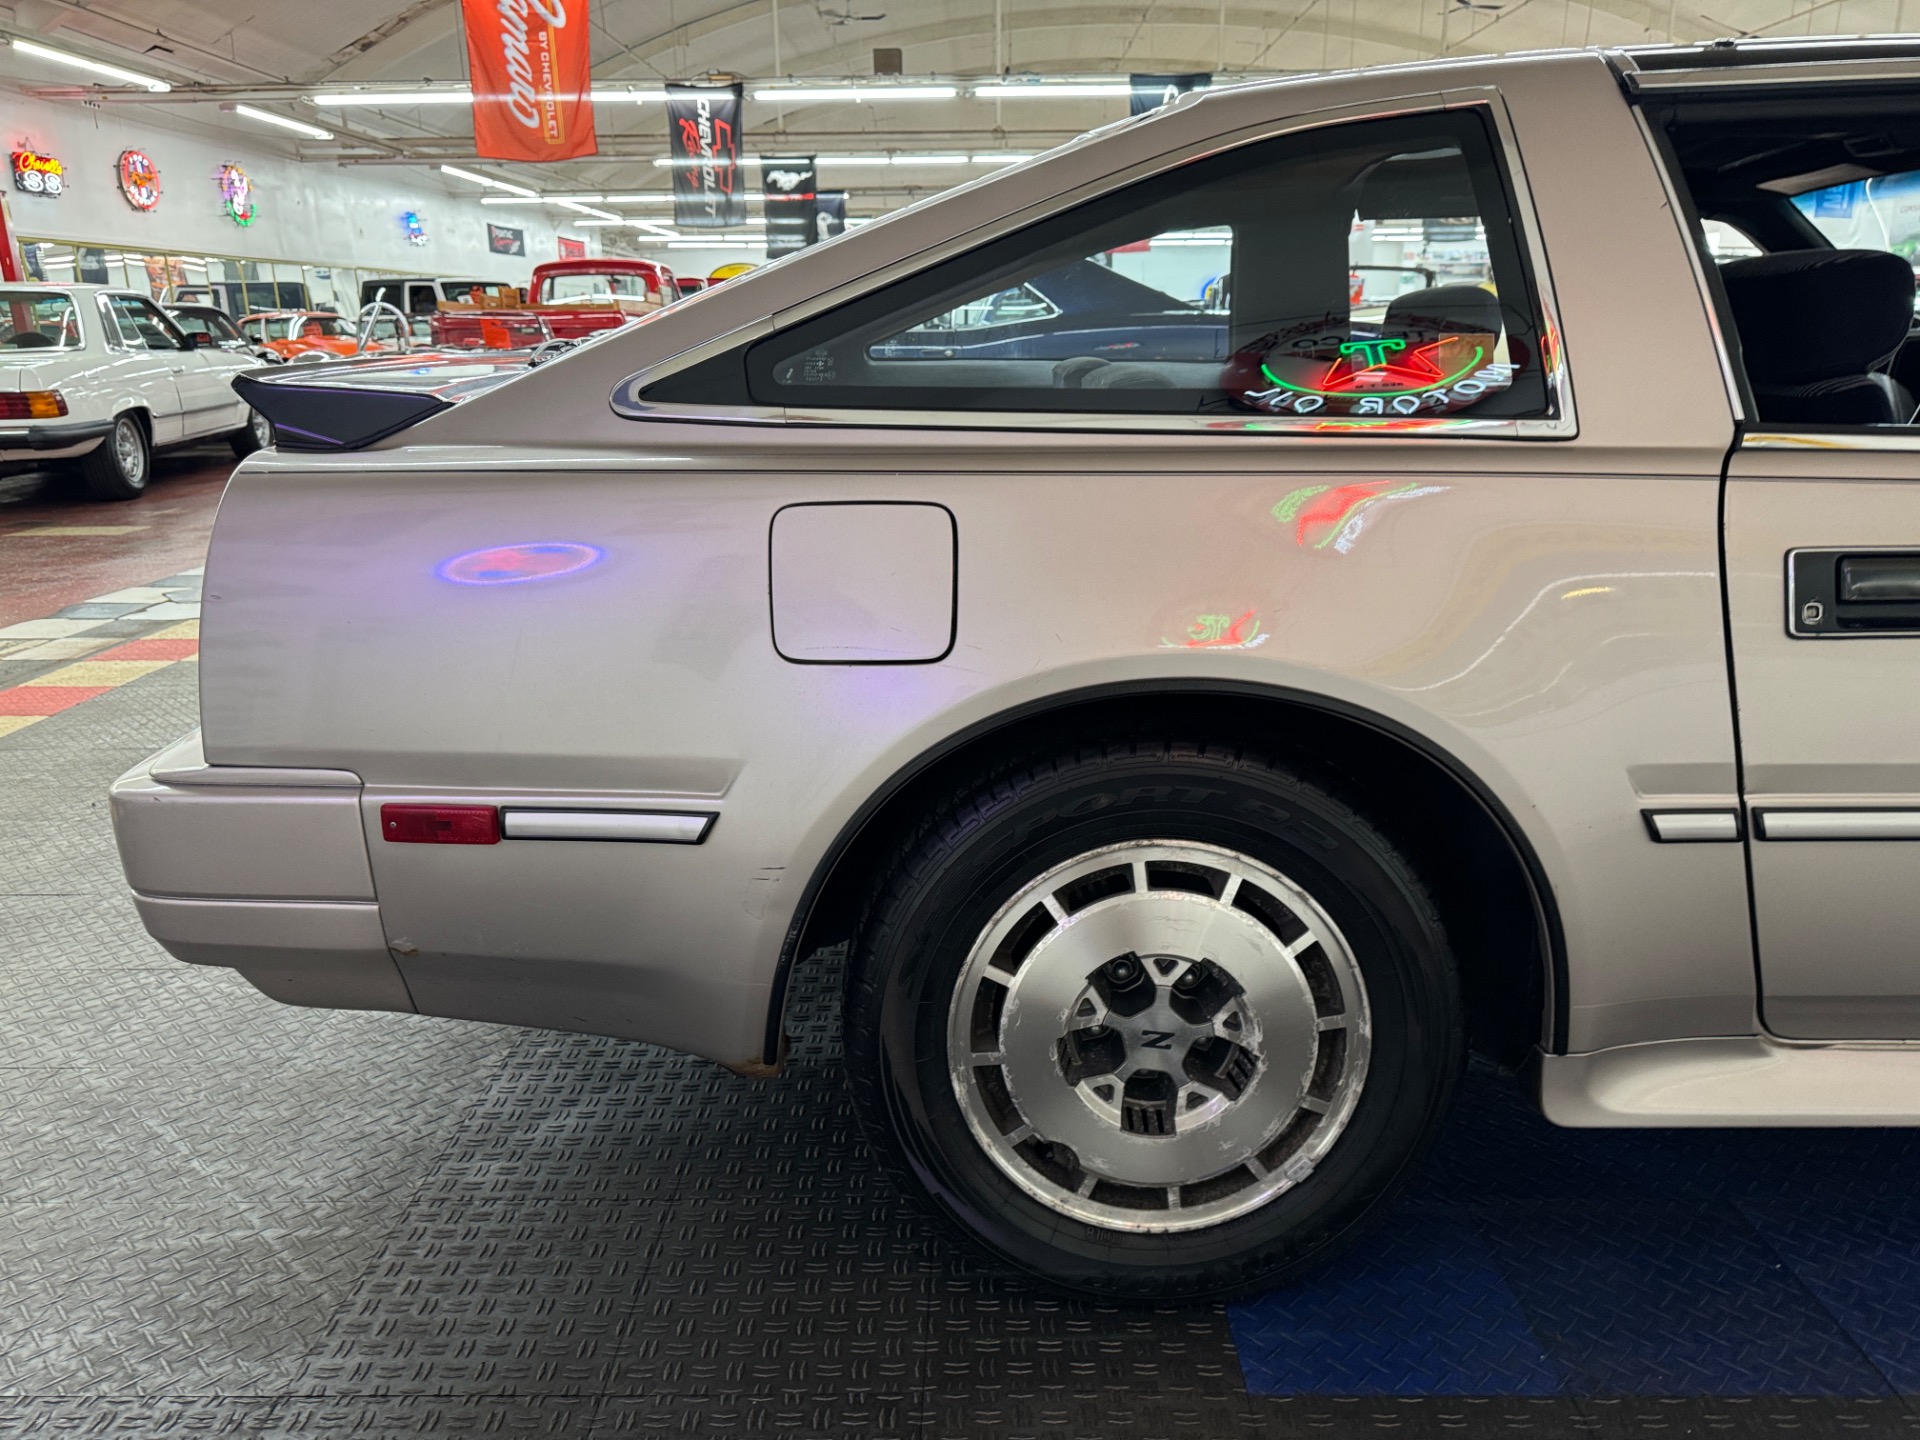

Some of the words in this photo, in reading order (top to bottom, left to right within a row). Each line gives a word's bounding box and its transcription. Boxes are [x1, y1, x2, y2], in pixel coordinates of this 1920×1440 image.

[538, 31, 549, 49] BY
[497, 0, 566, 128] amaro
[23, 170, 63, 194] SS
